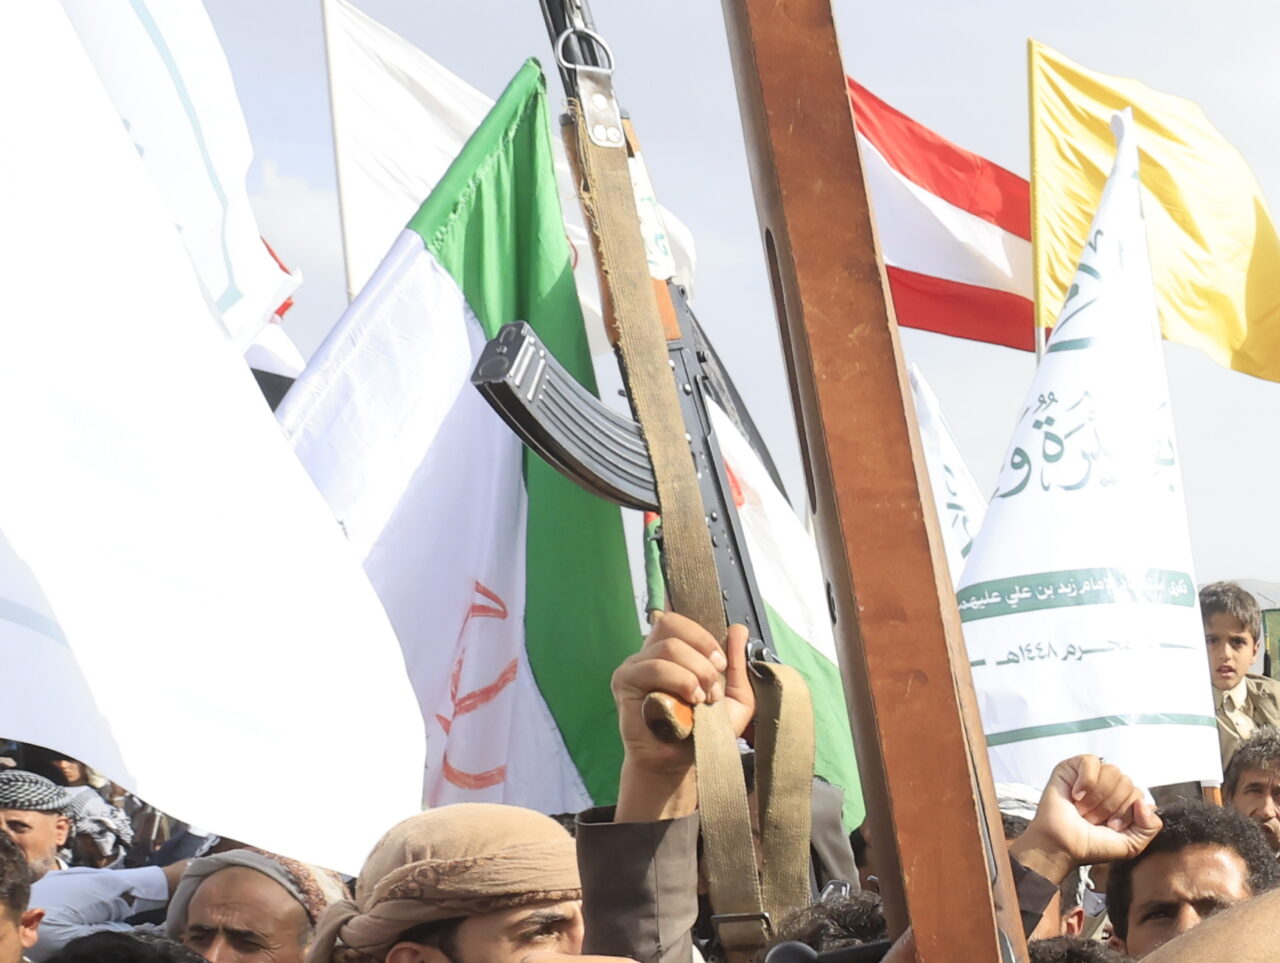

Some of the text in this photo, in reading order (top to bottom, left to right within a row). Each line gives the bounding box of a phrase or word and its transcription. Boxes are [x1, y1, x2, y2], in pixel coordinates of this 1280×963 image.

[1035, 585, 1055, 600] بن
[1057, 578, 1078, 596] زيد
[1005, 585, 1032, 608] علي
